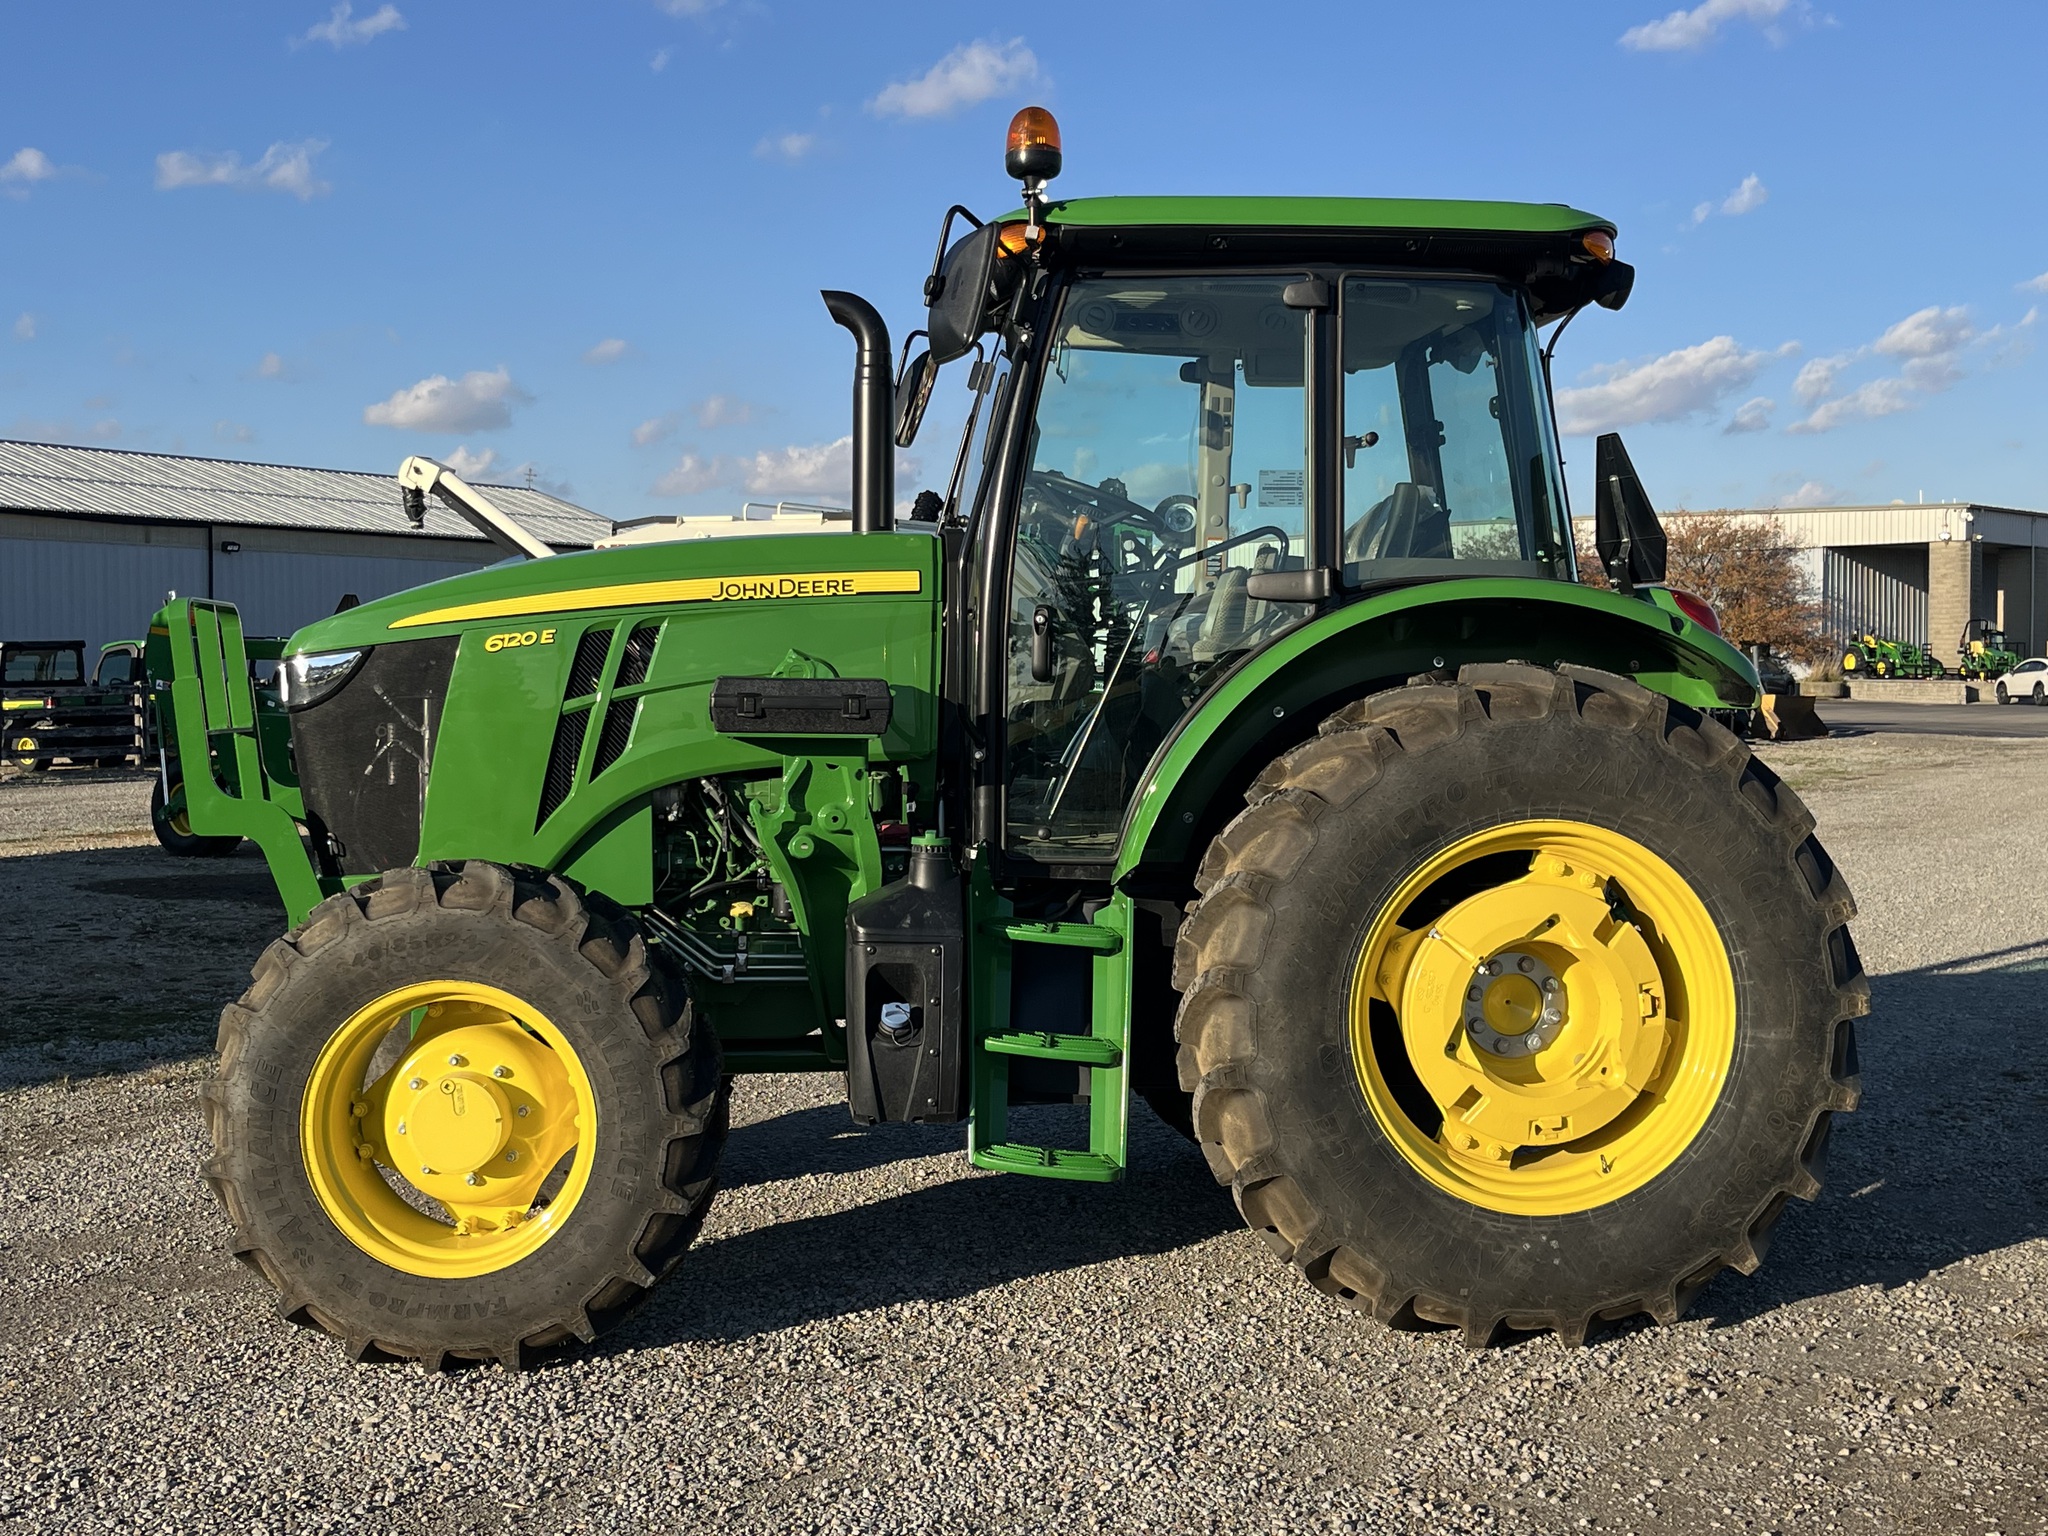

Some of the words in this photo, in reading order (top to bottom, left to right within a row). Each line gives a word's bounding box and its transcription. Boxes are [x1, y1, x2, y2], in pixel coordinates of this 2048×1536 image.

[484, 633, 537, 652] 6120
[542, 630, 558, 645] E
[712, 581, 774, 598] JOHN
[779, 578, 855, 595] DEERE
[1318, 781, 1469, 923] FARMPRO
[1578, 755, 1791, 931] ALLIANCE
[247, 1058, 314, 1256] ALLIANCE
[580, 1004, 647, 1206] ALLIANCE
[1298, 1110, 1518, 1280] ALLIANCE
[367, 1289, 509, 1320] FARMPRO
